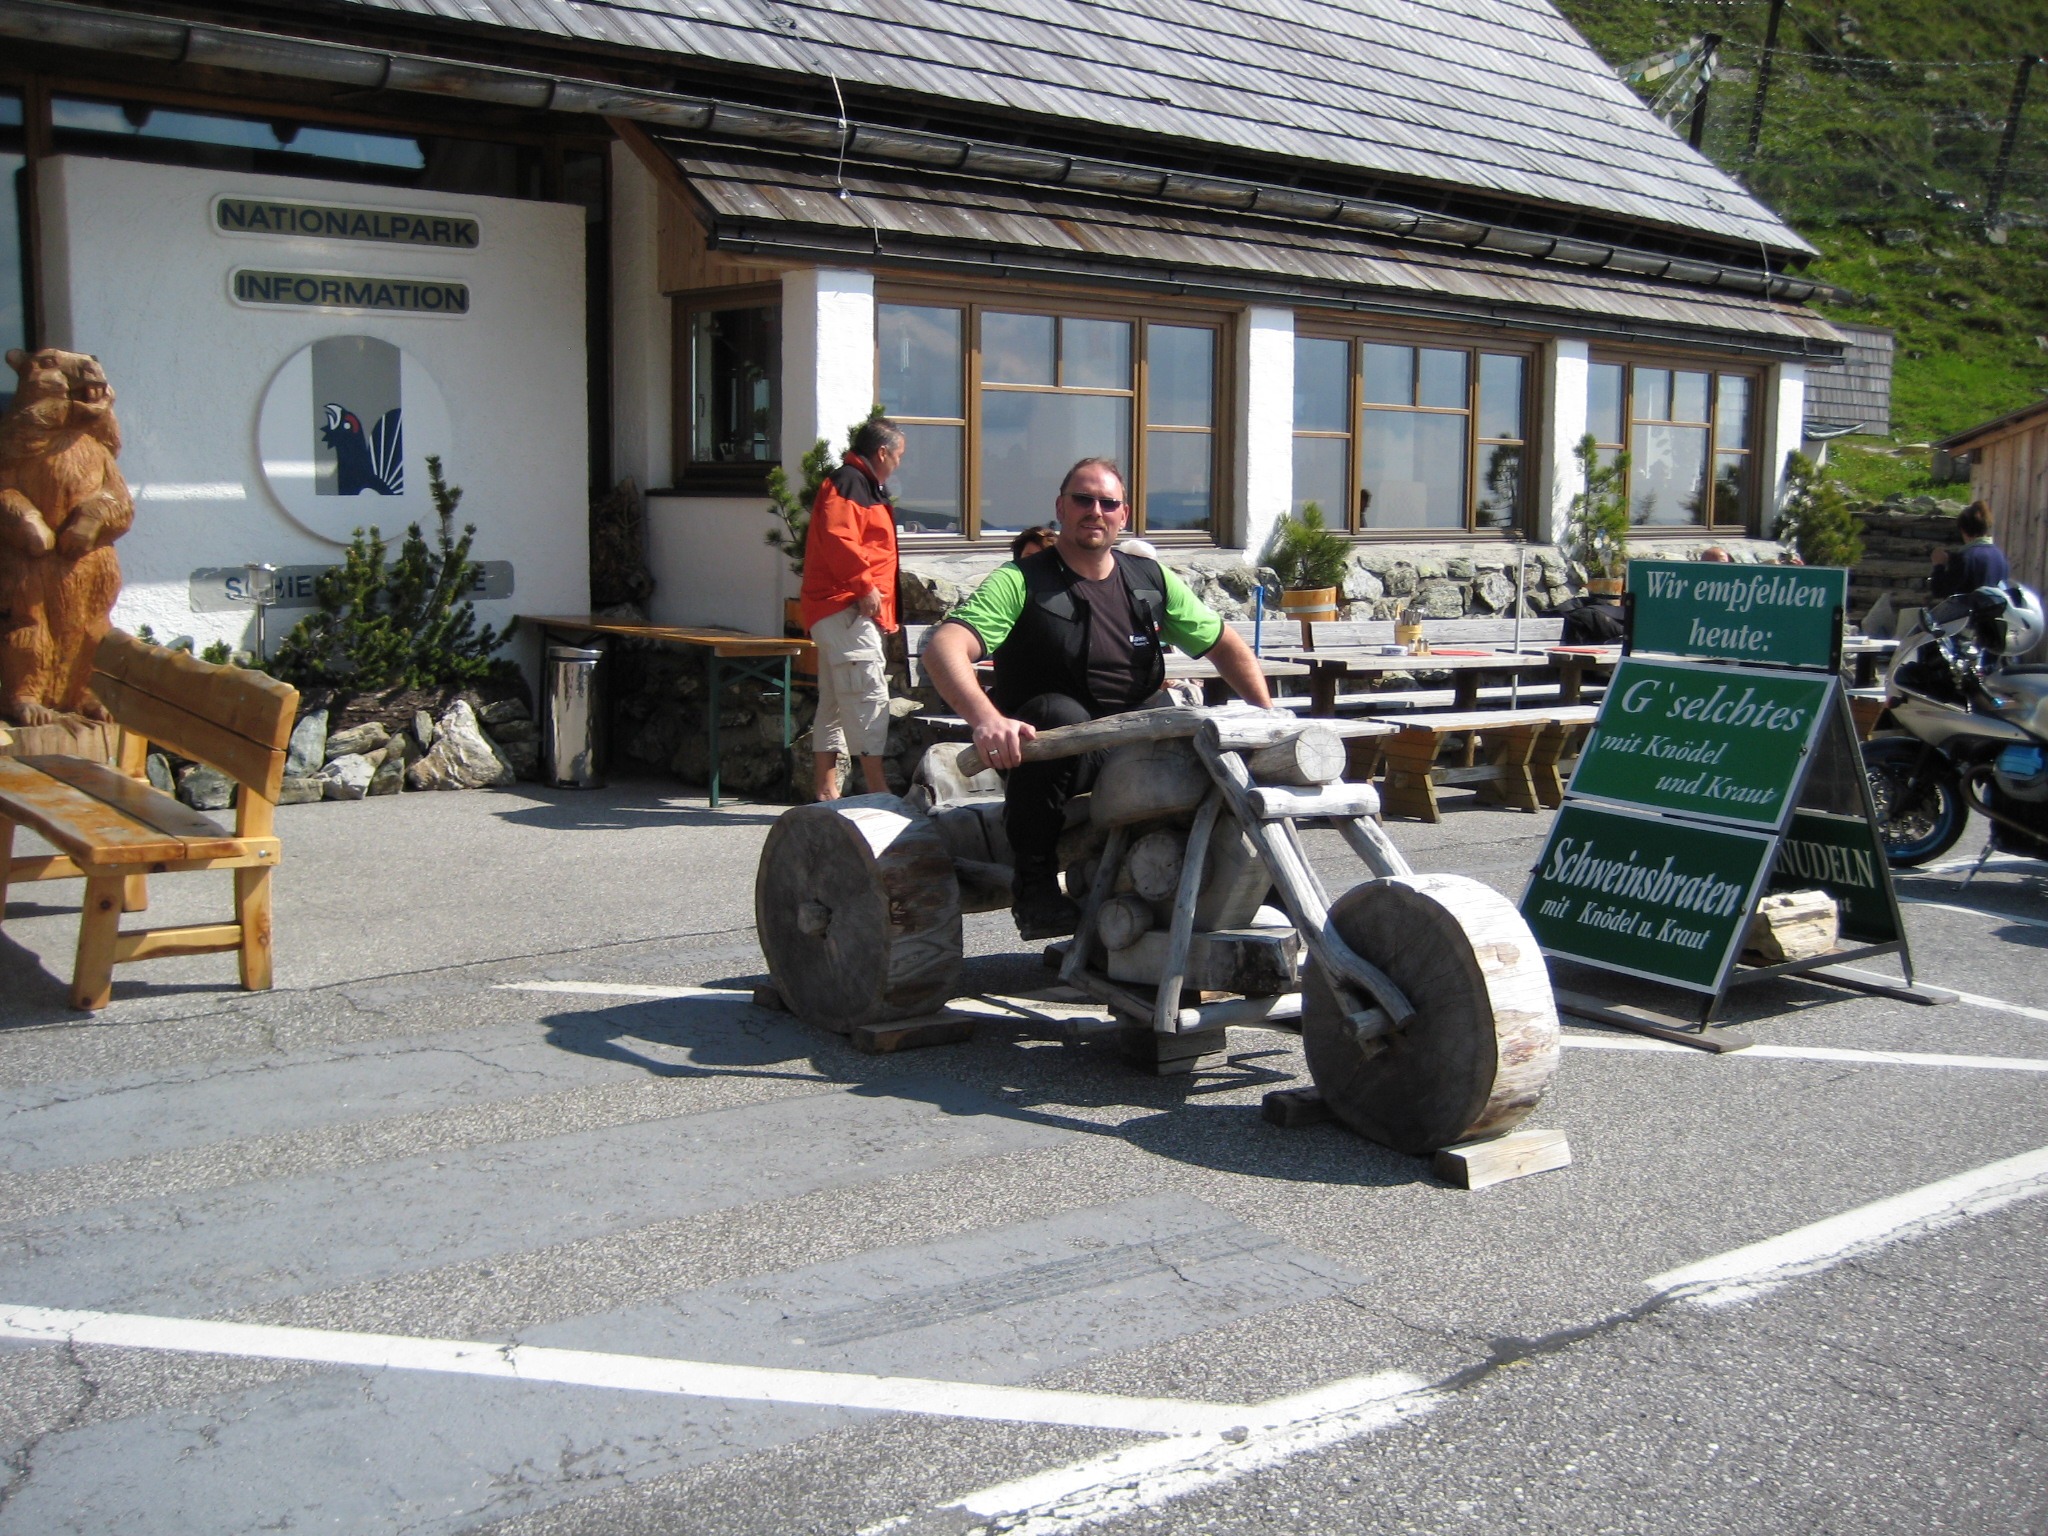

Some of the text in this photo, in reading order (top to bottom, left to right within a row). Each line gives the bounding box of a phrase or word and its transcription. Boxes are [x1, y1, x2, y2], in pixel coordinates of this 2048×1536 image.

[220, 202, 475, 245] NATIONALPARK
[238, 274, 466, 311] INFORMATION
[1647, 571, 1826, 613] Wir empfehlen
[1688, 618, 1773, 652] heute:
[1600, 733, 1728, 765] mit Knödel
[1655, 772, 1776, 805] und Kraut
[1543, 837, 1743, 918] Schweinsbraten
[1773, 838, 1876, 889] NUDELN
[1539, 896, 1711, 950] mit Knödel u. Kraut
